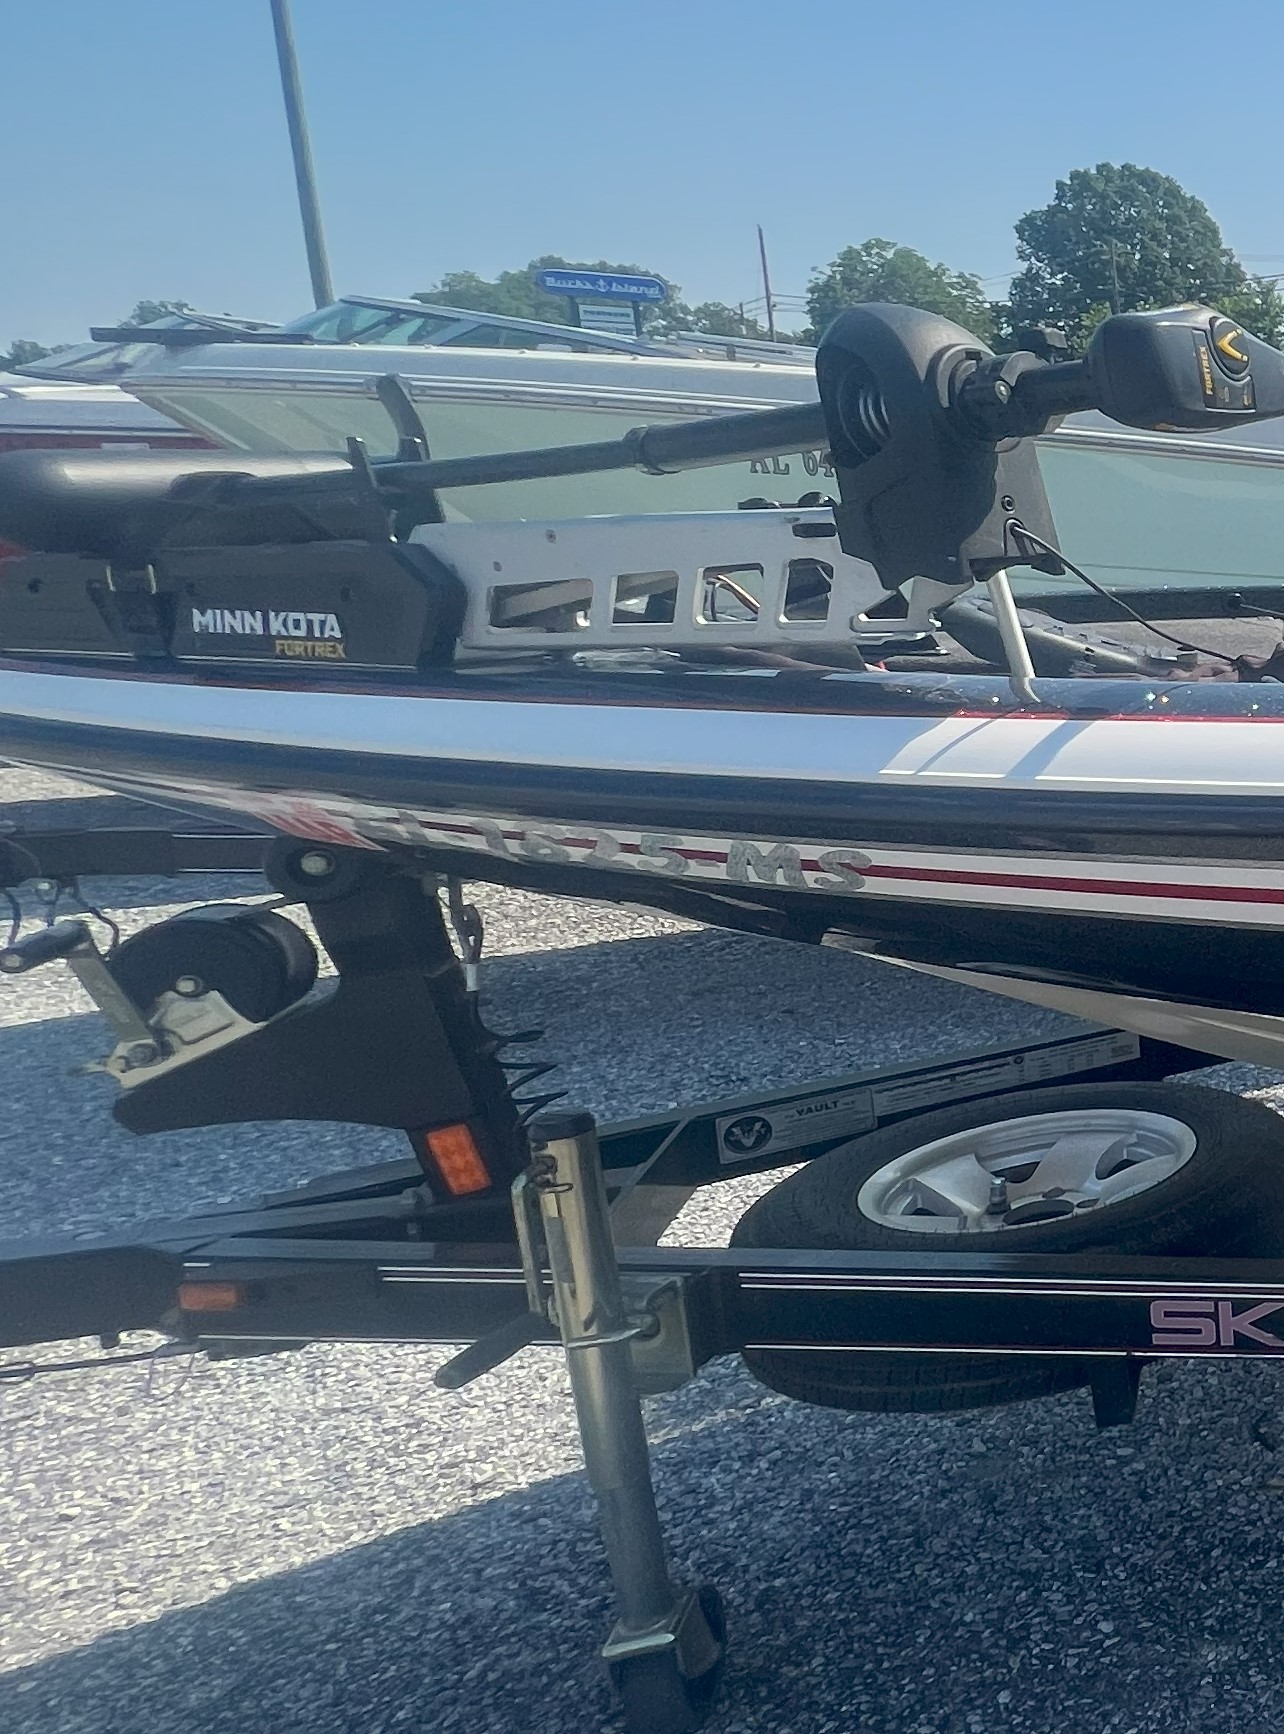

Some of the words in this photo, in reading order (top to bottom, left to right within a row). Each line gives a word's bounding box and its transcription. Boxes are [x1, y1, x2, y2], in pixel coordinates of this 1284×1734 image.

[192, 607, 264, 635] MINN
[268, 609, 342, 638] KOTA
[274, 639, 346, 658] FORTREX
[795, 1100, 840, 1117] VAULT
